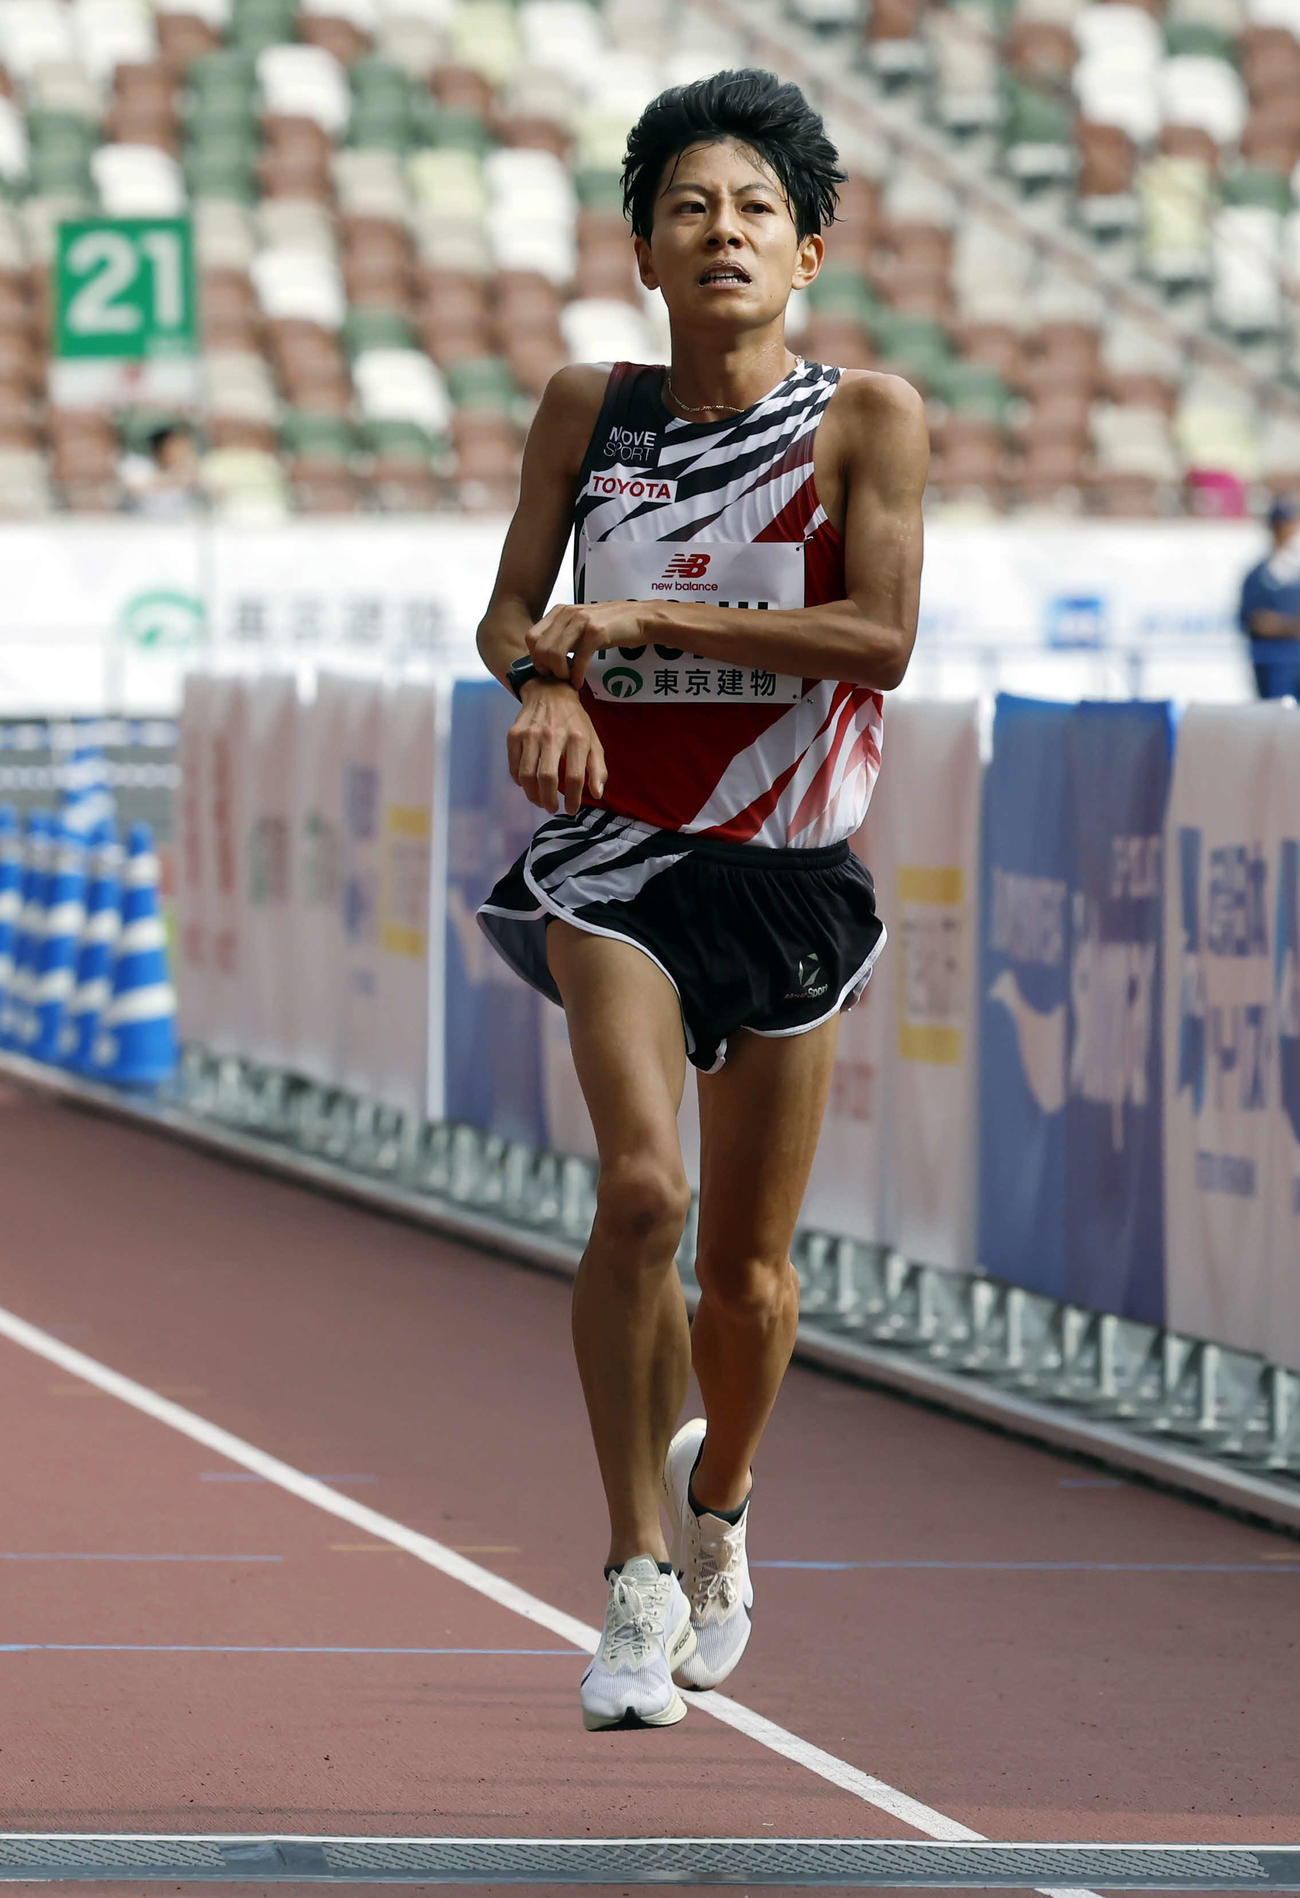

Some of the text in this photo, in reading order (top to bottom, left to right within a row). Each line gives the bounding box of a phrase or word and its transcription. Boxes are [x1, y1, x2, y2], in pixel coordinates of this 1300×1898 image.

[65, 229, 184, 336] 21
[609, 426, 657, 447] NOVE
[603, 441, 654, 461] SPORT
[593, 475, 671, 499] TOYOTA
[651, 581, 719, 591] new balance
[653, 668, 777, 697] 東京建物
